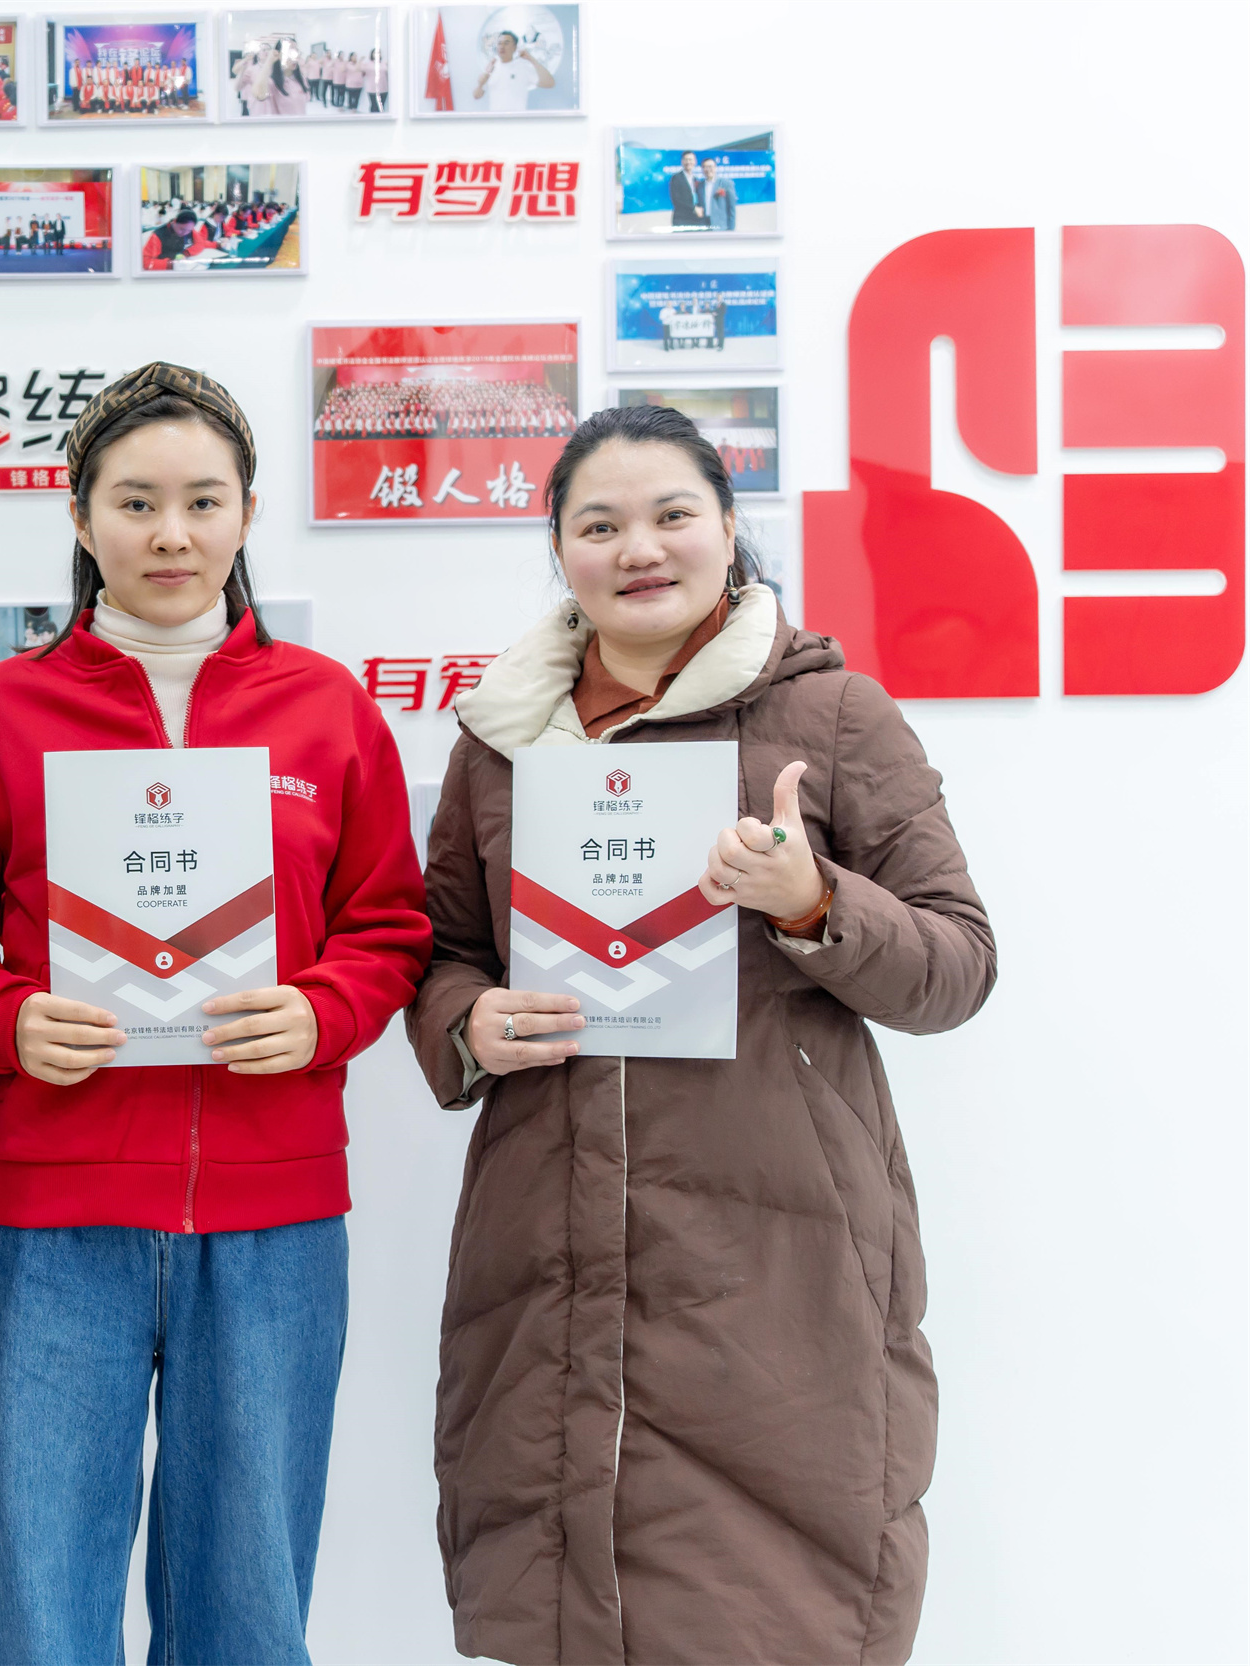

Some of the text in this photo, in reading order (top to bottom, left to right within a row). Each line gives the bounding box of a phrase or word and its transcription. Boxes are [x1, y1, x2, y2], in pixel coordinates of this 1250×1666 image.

[359, 160, 579, 217] 有梦想
[593, 799, 644, 812] 锋格练字
[134, 812, 185, 824] 锋格练字
[579, 837, 656, 862] 合同书
[123, 849, 199, 874] 合同书
[592, 873, 643, 884] 品牌加盟
[137, 884, 188, 896] 品牌加盟
[591, 888, 644, 897] COOPERATE
[136, 899, 188, 908] COOPERATE
